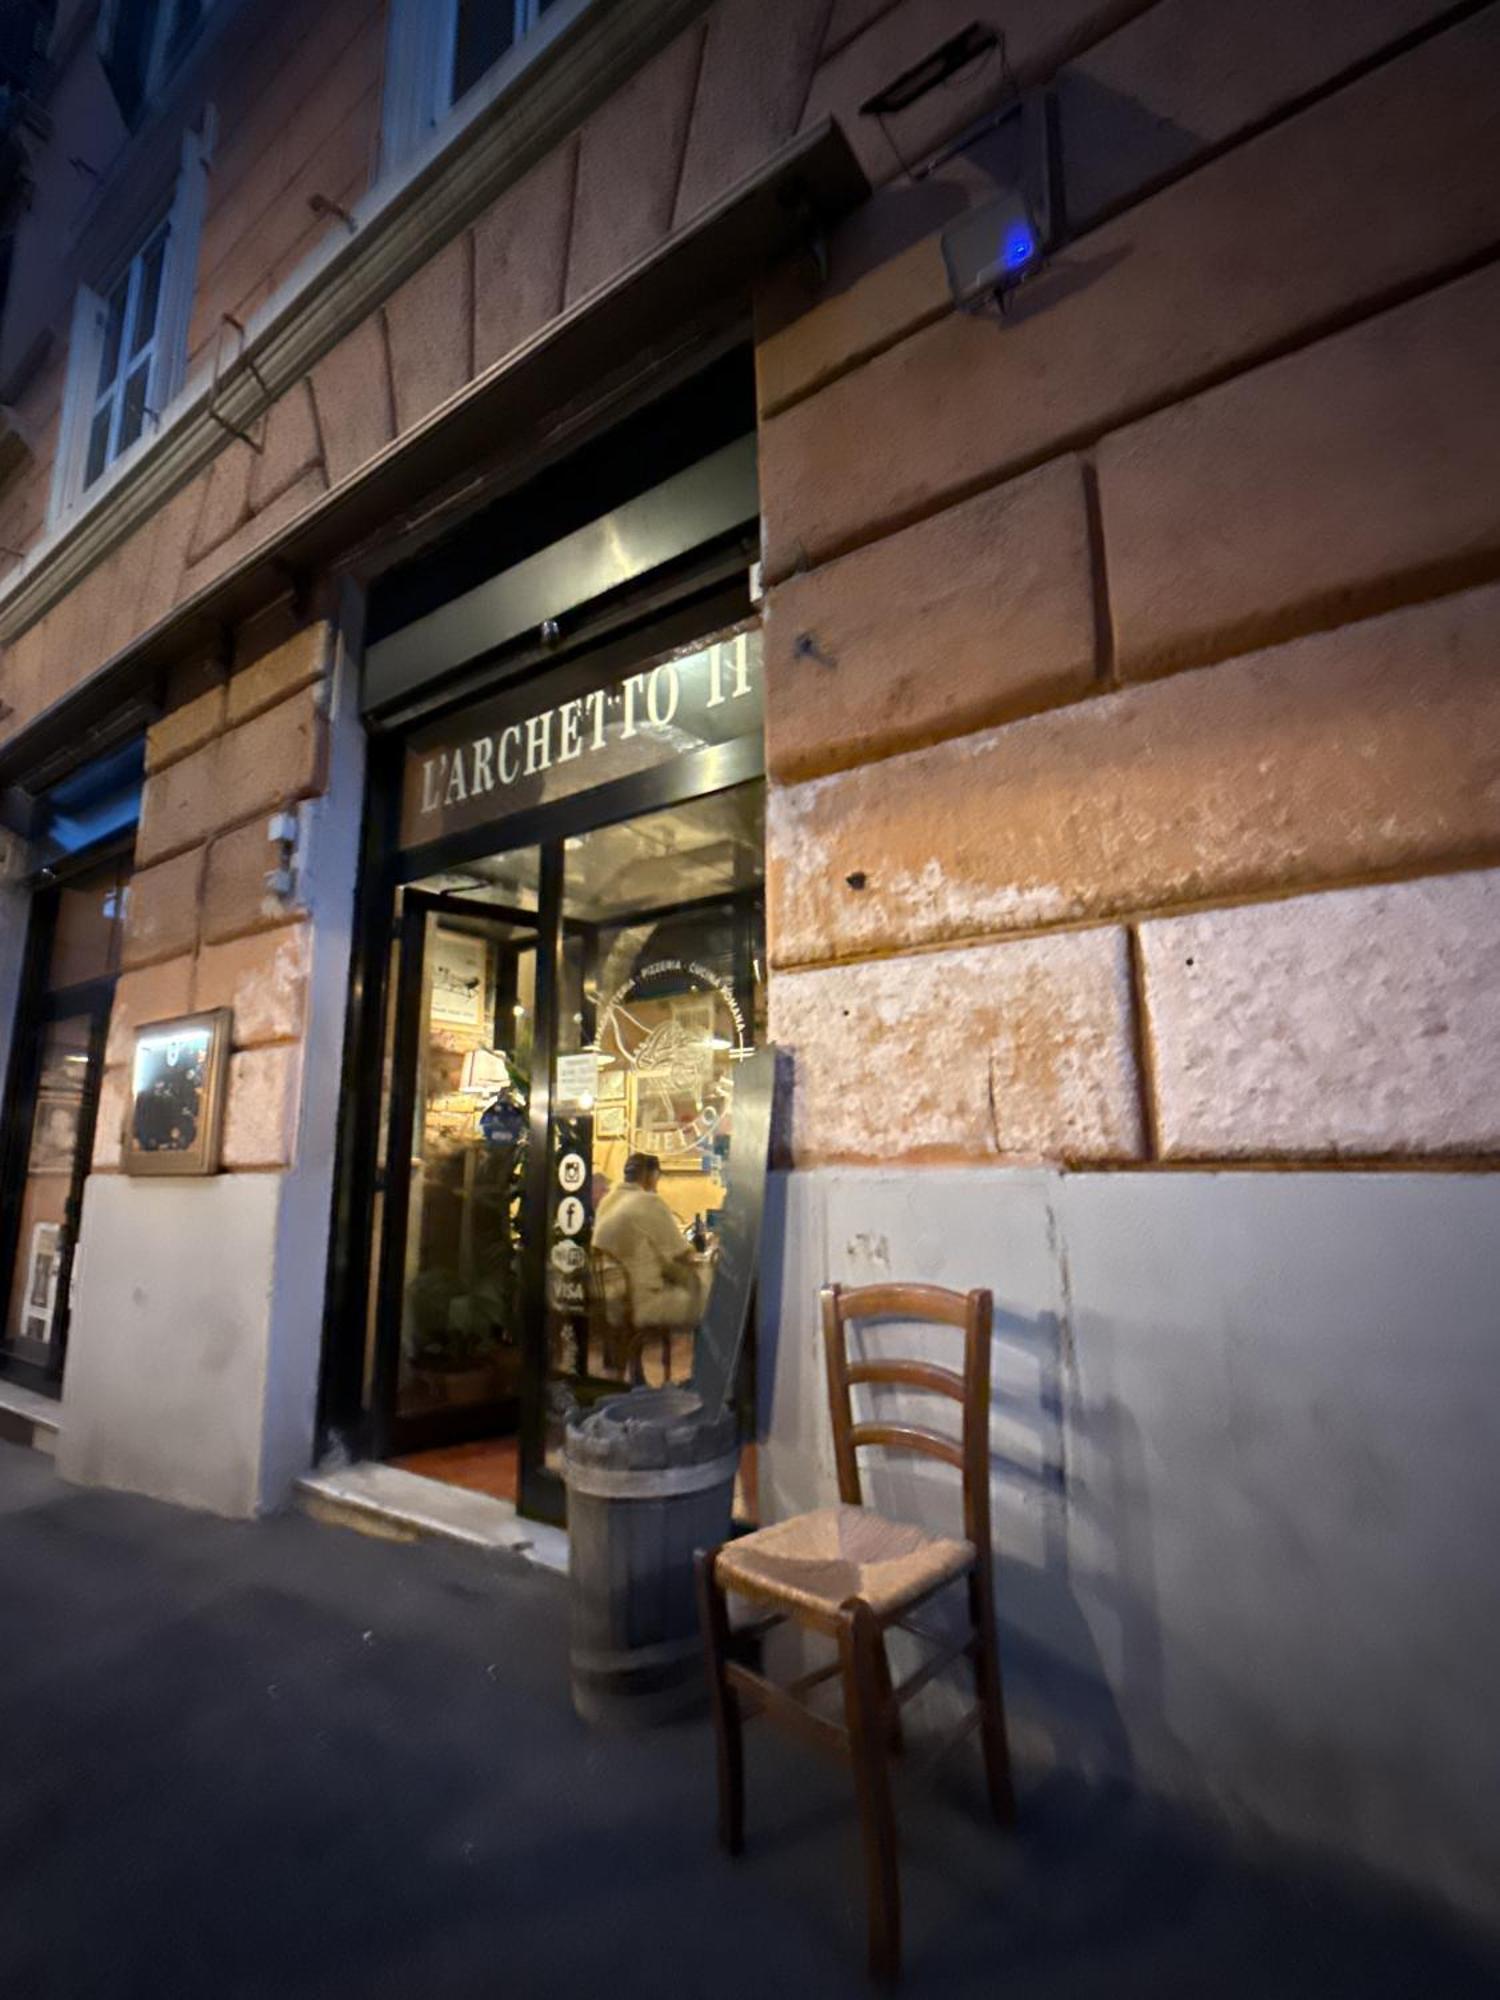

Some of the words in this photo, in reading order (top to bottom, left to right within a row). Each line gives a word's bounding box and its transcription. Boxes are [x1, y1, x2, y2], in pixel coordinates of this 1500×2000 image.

[420, 661, 680, 815] L'ARCHETTO
[706, 631, 752, 709] II
[553, 1282, 585, 1300] VISA
